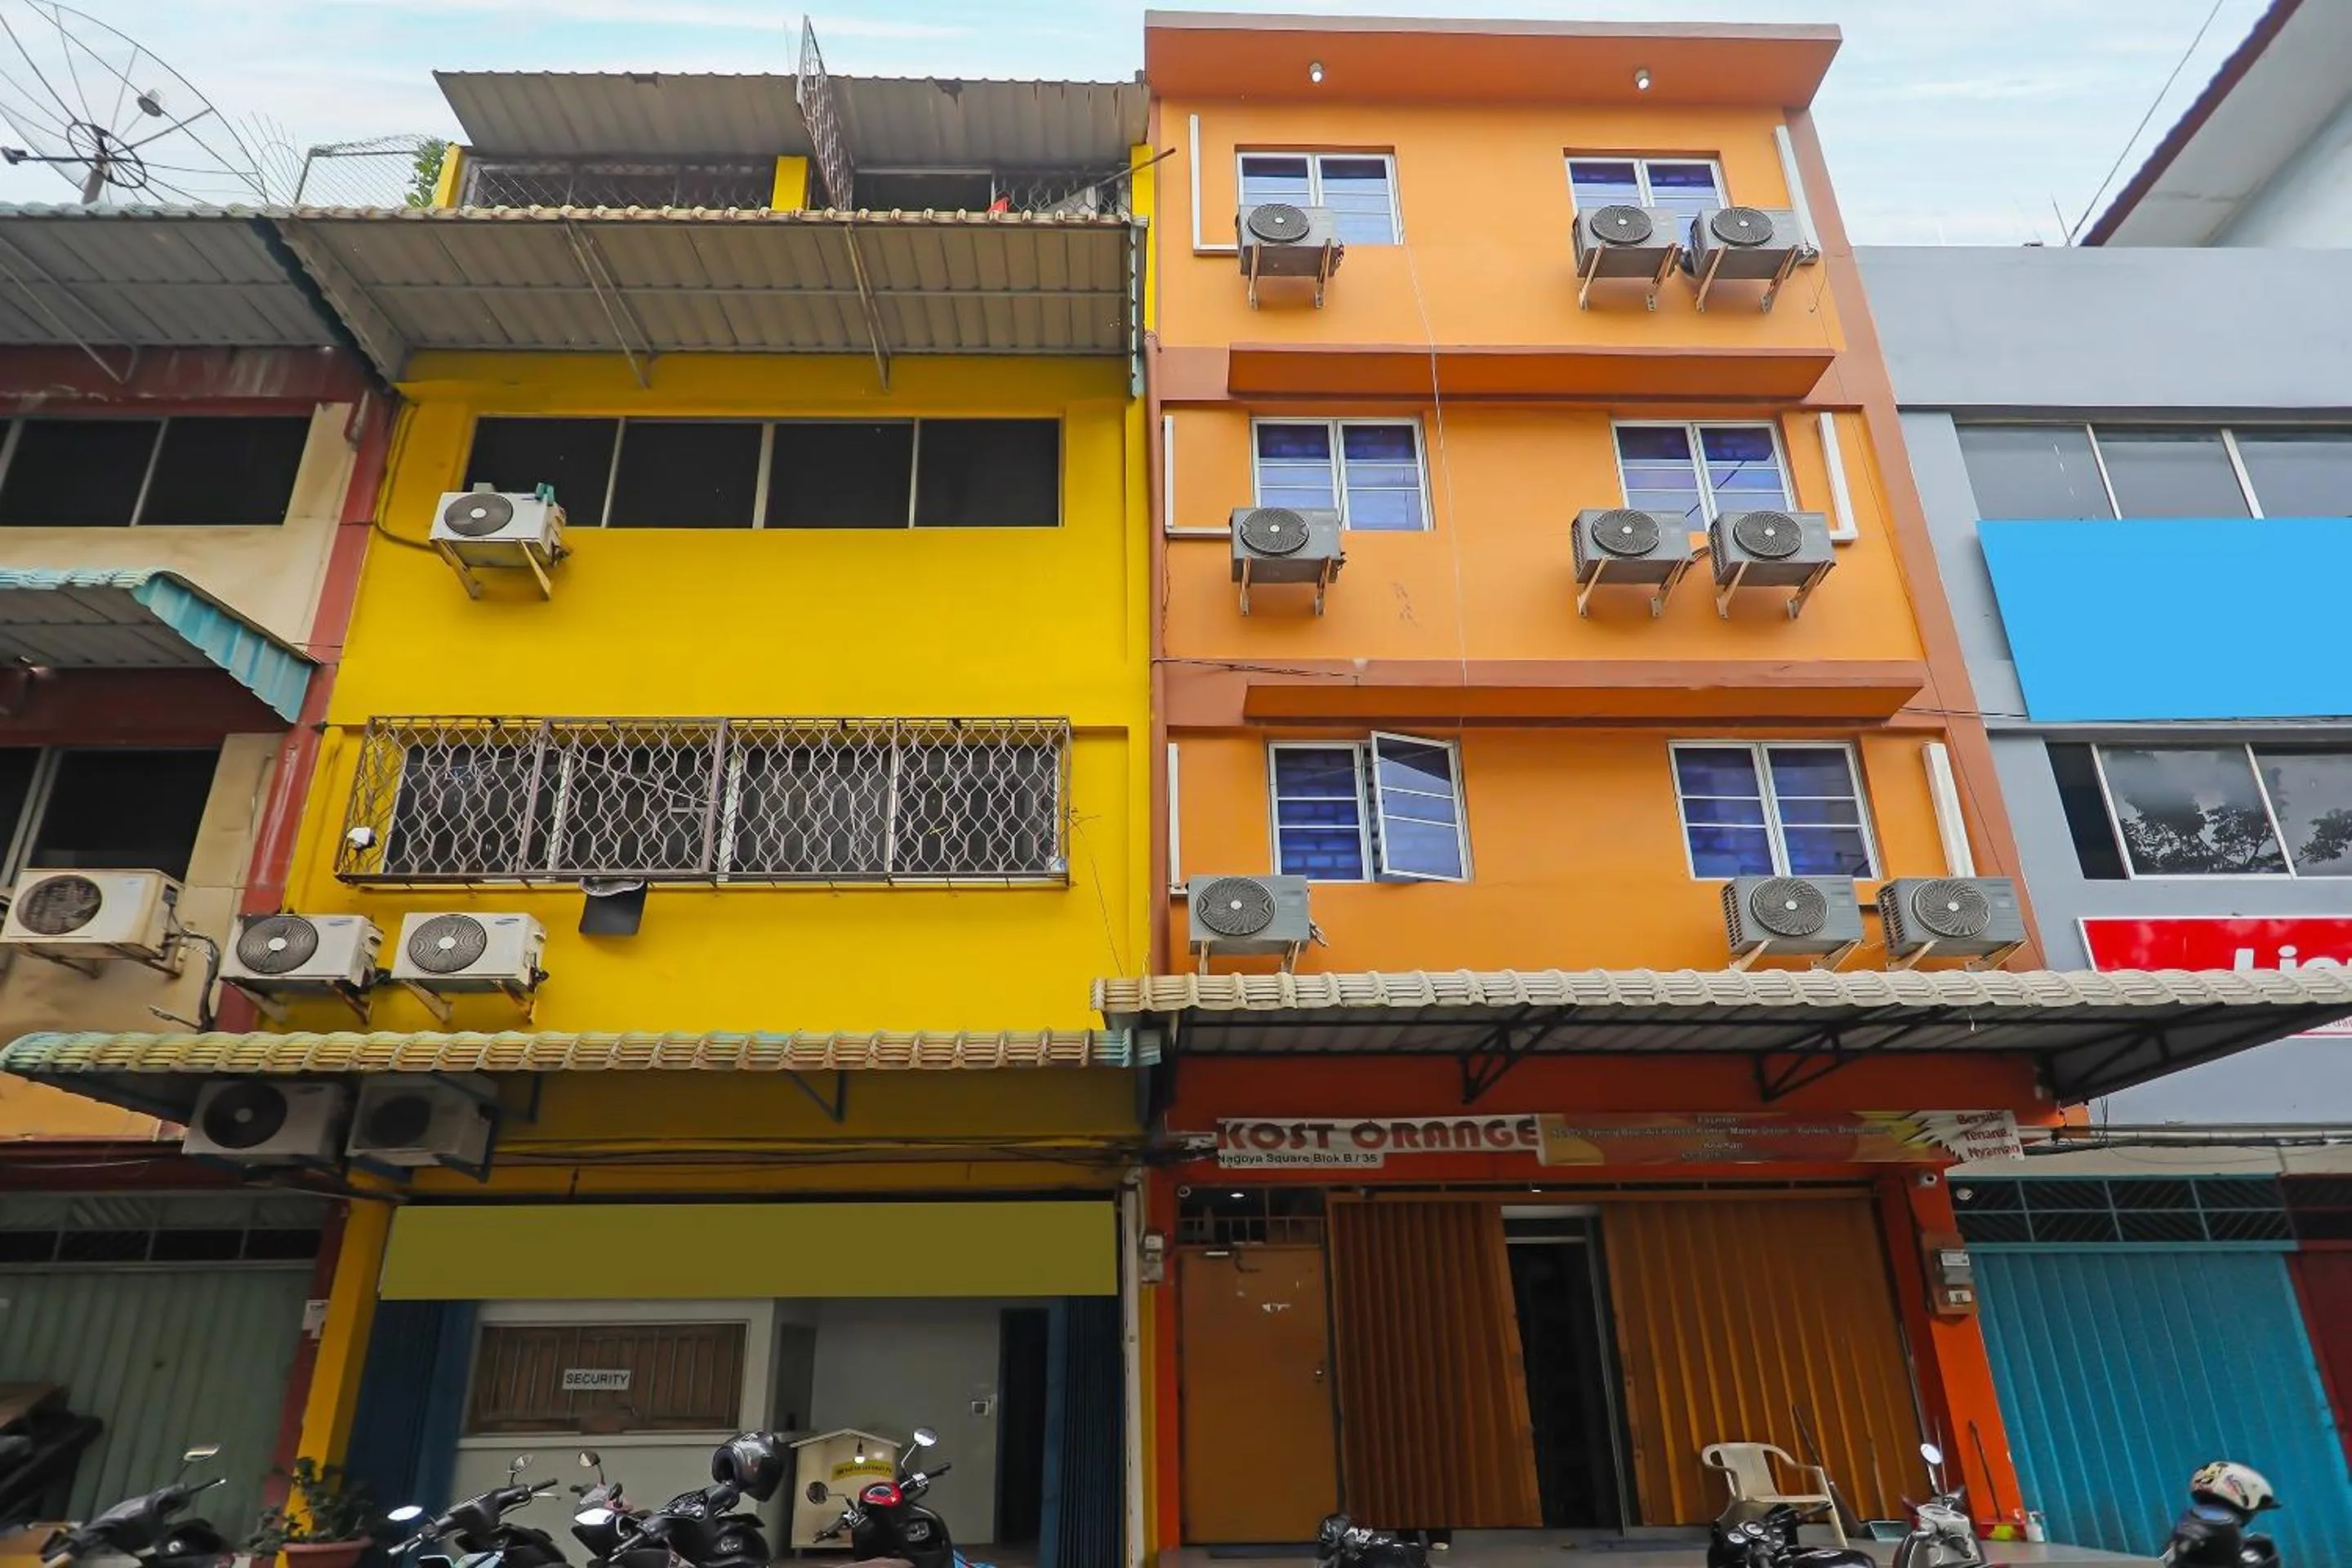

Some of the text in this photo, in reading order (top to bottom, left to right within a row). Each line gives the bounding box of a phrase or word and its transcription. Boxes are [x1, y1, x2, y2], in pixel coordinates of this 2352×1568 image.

[1218, 1119, 1539, 1149] KOST ORANGE
[1267, 1153, 1310, 1163] Square
[1313, 1153, 1340, 1162] Blok
[566, 1373, 628, 1384] SECURITY
